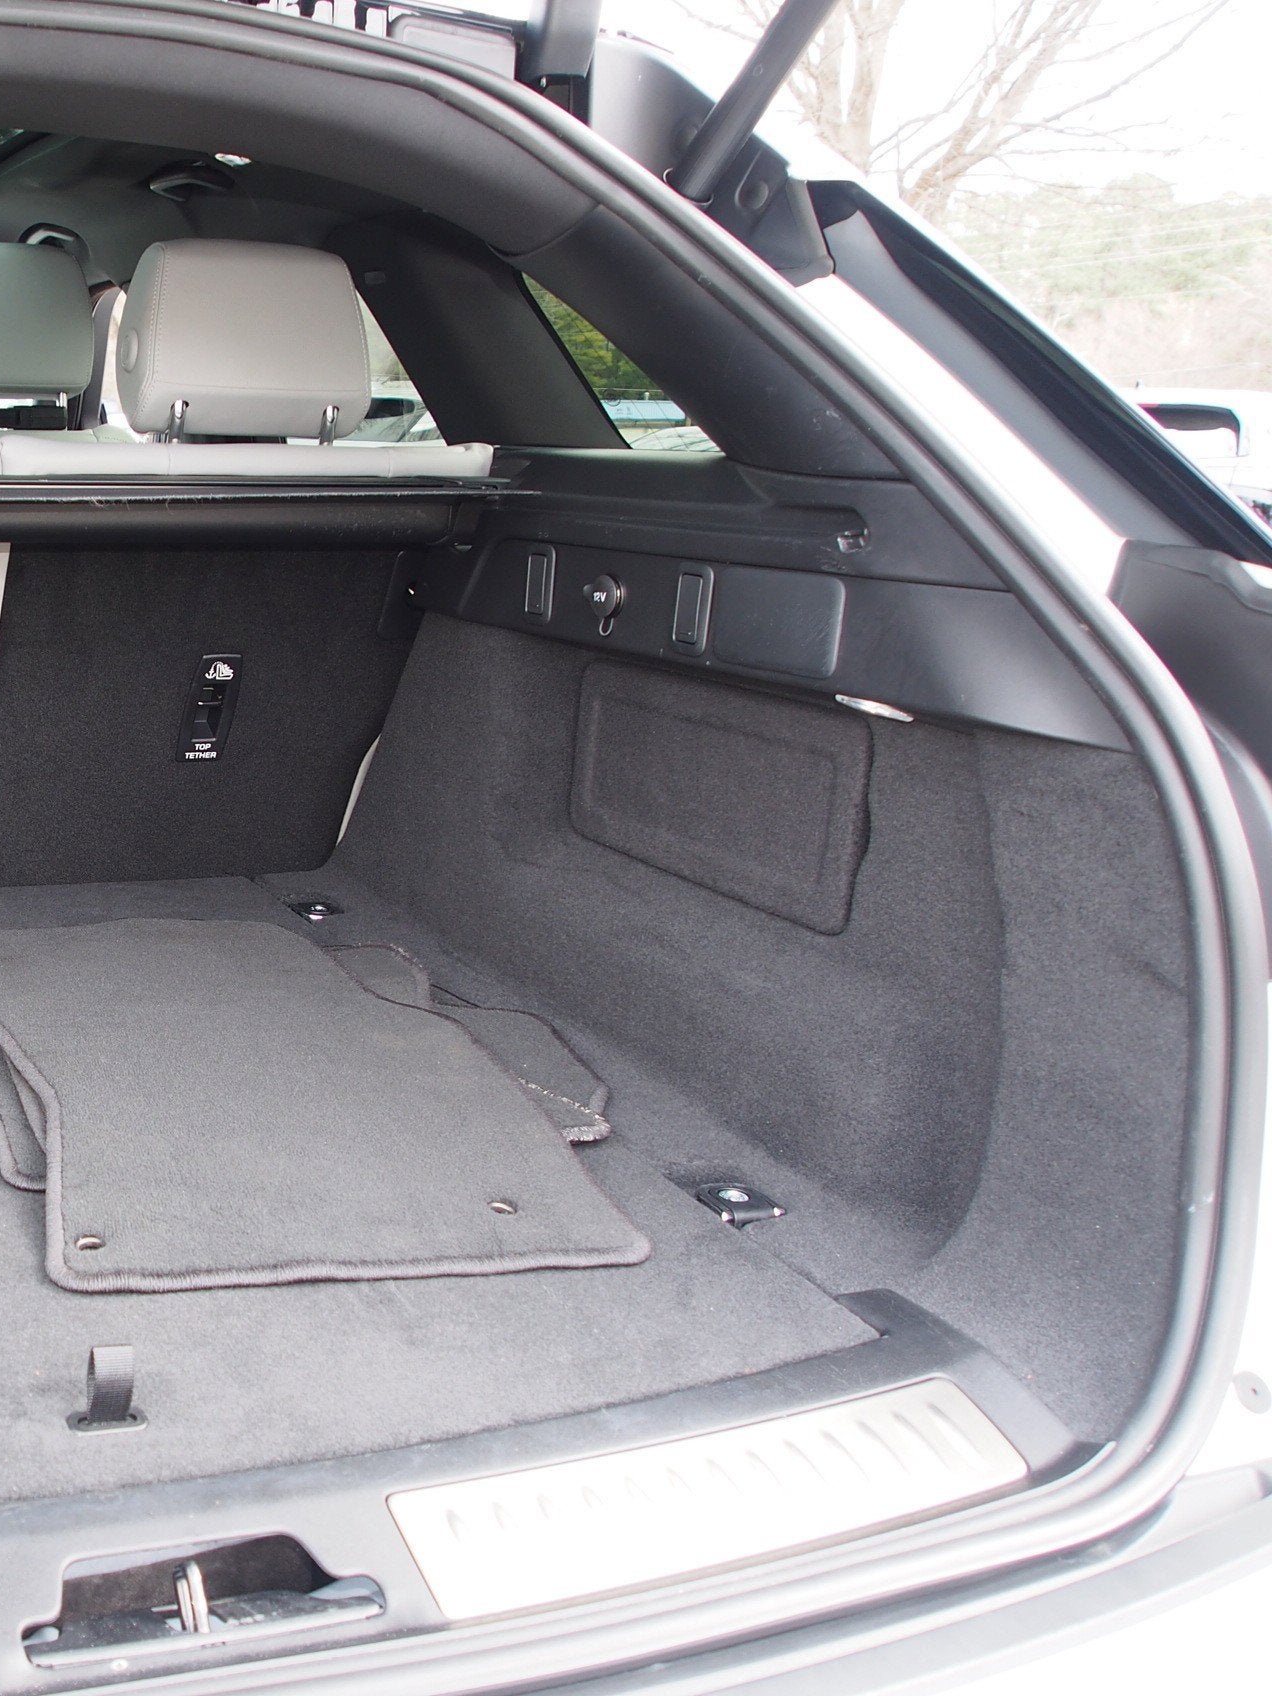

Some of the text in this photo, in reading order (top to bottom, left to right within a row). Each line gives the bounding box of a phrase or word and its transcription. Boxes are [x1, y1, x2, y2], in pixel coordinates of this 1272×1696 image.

[593, 591, 607, 602] 12V
[194, 743, 212, 751] TOP
[184, 751, 217, 759] TETHER
